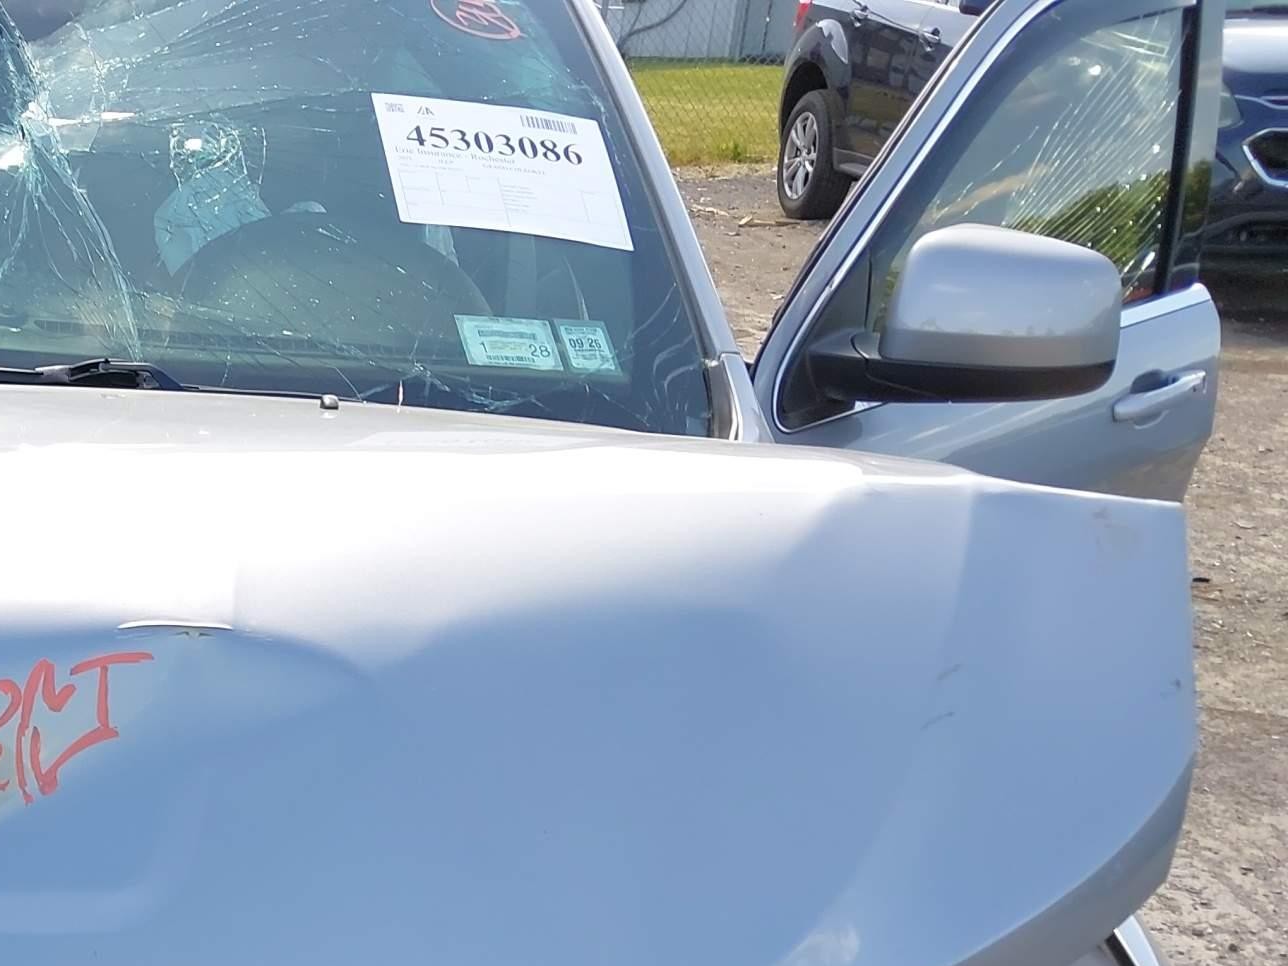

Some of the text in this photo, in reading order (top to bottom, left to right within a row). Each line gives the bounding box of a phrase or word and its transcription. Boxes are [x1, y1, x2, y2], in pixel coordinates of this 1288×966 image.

[406, 125, 583, 165] 45303086
[528, 343, 551, 358] 28
[568, 337, 602, 349] 09 26
